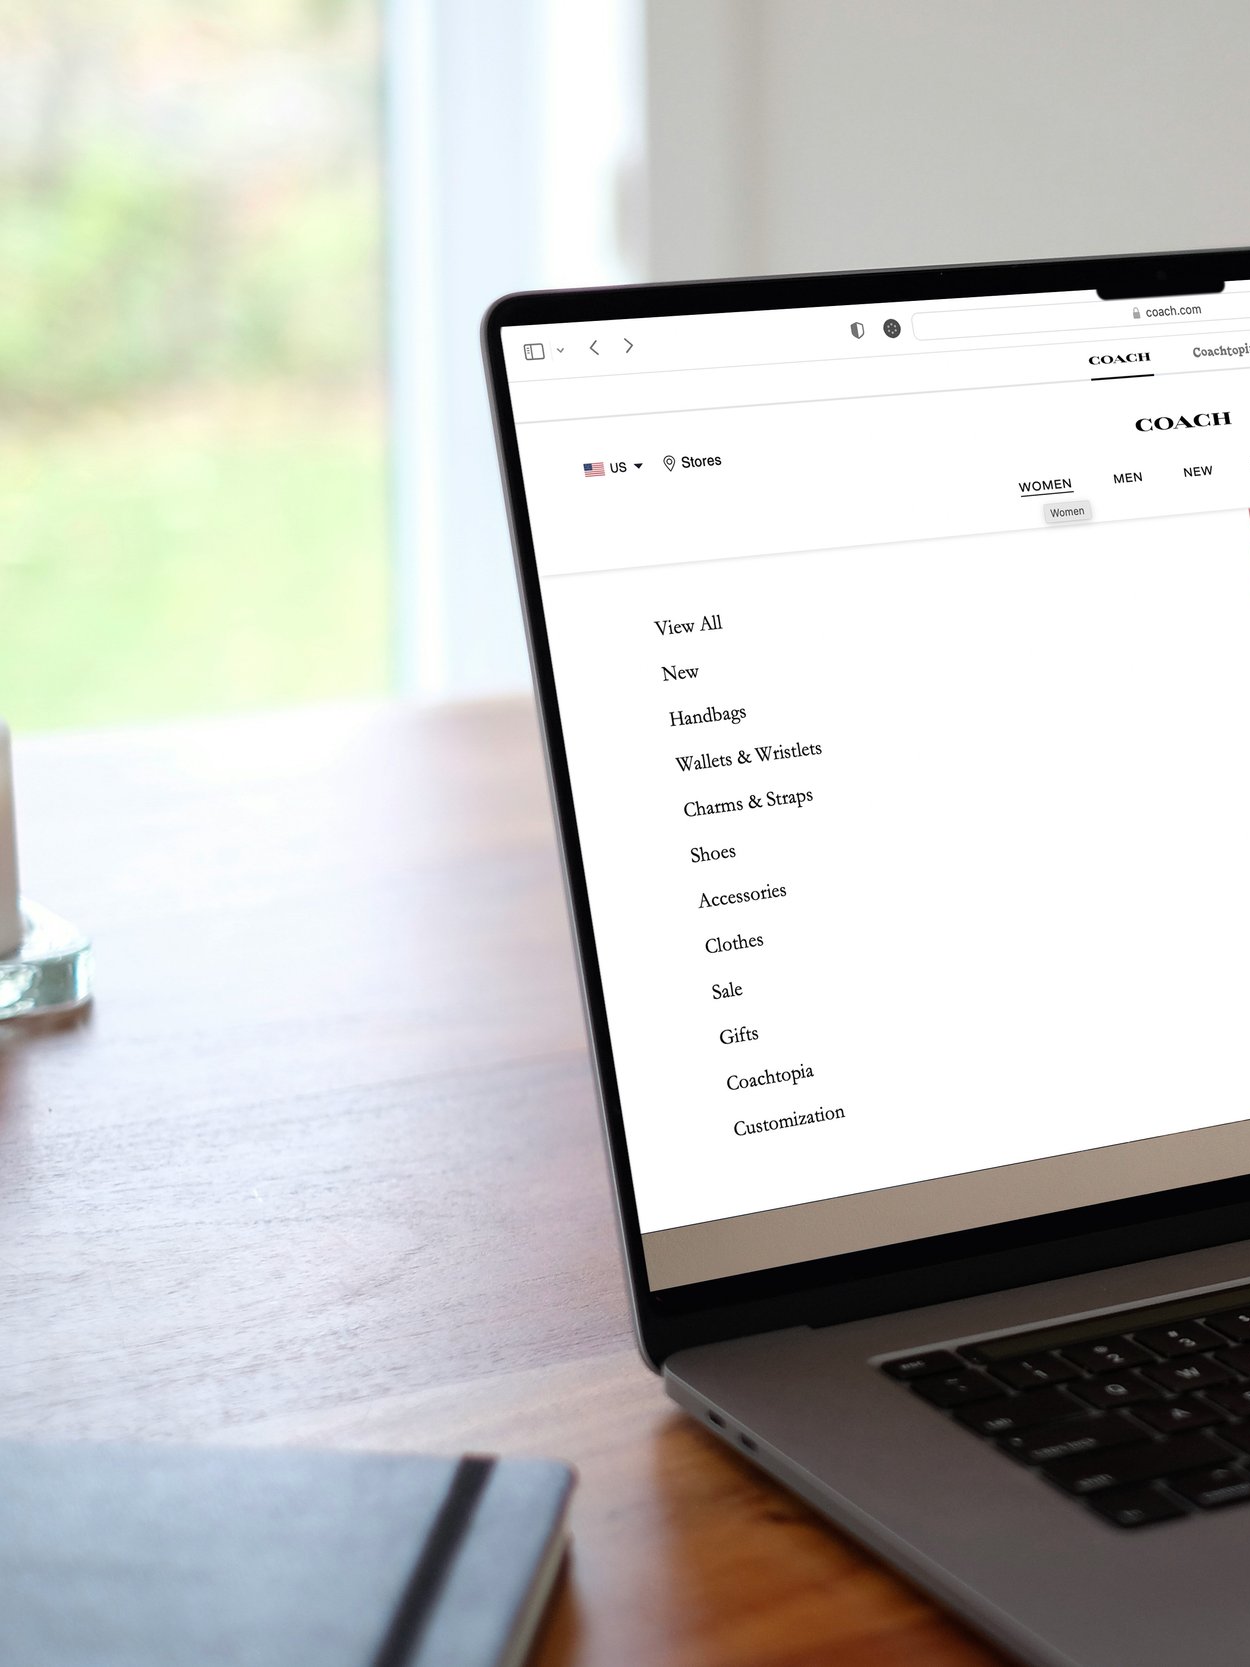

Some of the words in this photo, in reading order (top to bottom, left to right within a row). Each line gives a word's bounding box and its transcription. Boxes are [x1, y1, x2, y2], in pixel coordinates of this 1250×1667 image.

[1145, 305, 1202, 318] coach.com
[1088, 351, 1151, 366] COACH
[1134, 411, 1233, 433] COACH
[609, 461, 628, 474] US
[680, 455, 722, 469] Stores
[1018, 477, 1073, 494] WOMEN
[1113, 471, 1143, 485] MEN
[1183, 465, 1213, 478] NEW
[1049, 507, 1085, 519] Women
[653, 619, 695, 636] View
[699, 614, 724, 632] All
[660, 664, 700, 682] New
[668, 705, 747, 727] Handbags
[674, 752, 733, 773] Wallets
[737, 749, 753, 765] &
[753, 741, 823, 763] Wristlets
[683, 800, 744, 818] Charms
[747, 794, 764, 810] &
[765, 790, 814, 809] Straps
[690, 846, 737, 864] Shoes
[698, 883, 787, 909] Accessories
[704, 933, 764, 954] Clothes
[711, 981, 744, 1000] Sale
[719, 1025, 759, 1045] Gifts
[726, 1063, 815, 1091] Coachtopia
[733, 1106, 846, 1137] Customization
[1174, 1367, 1200, 1379] W
